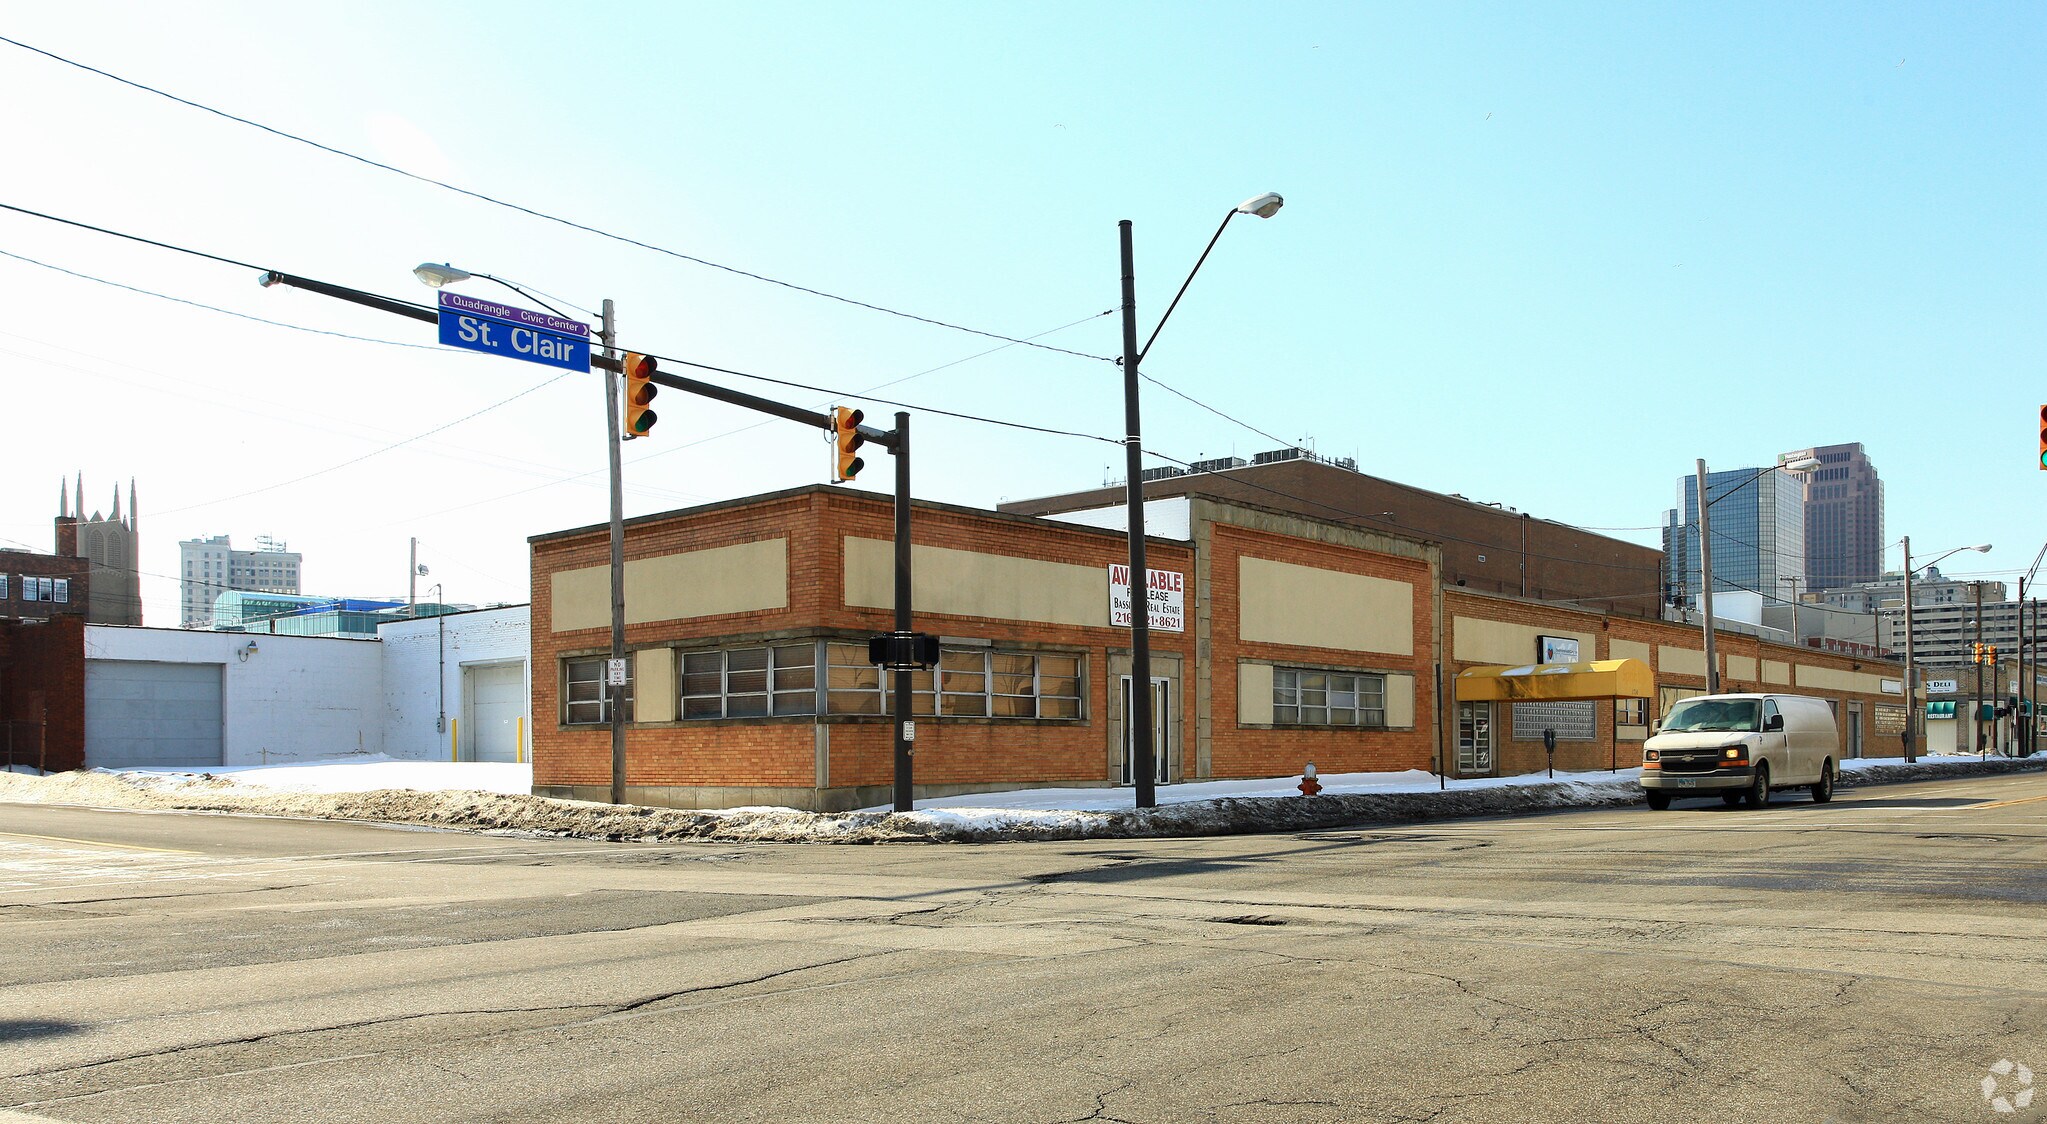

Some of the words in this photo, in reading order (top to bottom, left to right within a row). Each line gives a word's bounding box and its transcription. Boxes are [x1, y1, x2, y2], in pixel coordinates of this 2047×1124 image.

[453, 296, 511, 317] Quadrangle
[521, 311, 544, 324] Civic
[547, 317, 579, 332] Center
[458, 316, 498, 347] St.
[511, 328, 574, 362] Clair
[1112, 566, 1182, 592] AVABLE
[1146, 590, 1169, 602] LEASE
